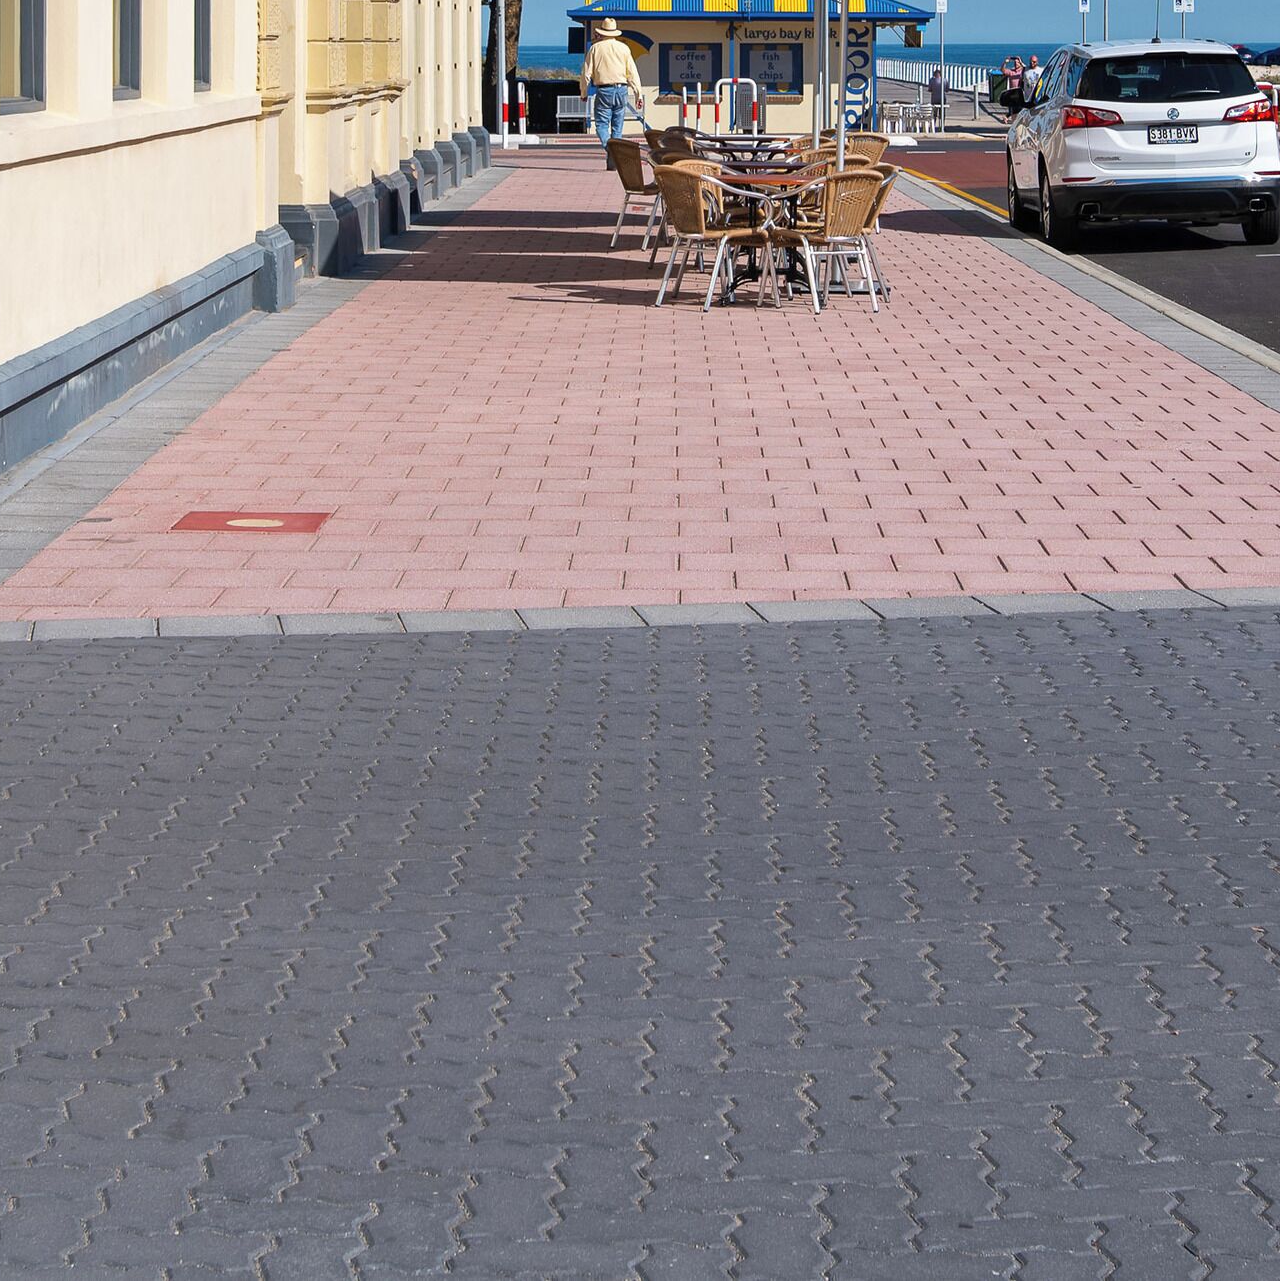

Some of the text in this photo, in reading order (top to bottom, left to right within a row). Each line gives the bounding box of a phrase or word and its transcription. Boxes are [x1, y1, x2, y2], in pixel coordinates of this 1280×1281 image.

[744, 27, 838, 41] largs bay kik
[675, 51, 706, 61] coffee
[762, 51, 780, 61] fish
[687, 61, 694, 70] &
[767, 61, 775, 70] &
[679, 70, 702, 79] cake
[758, 70, 784, 81] chips
